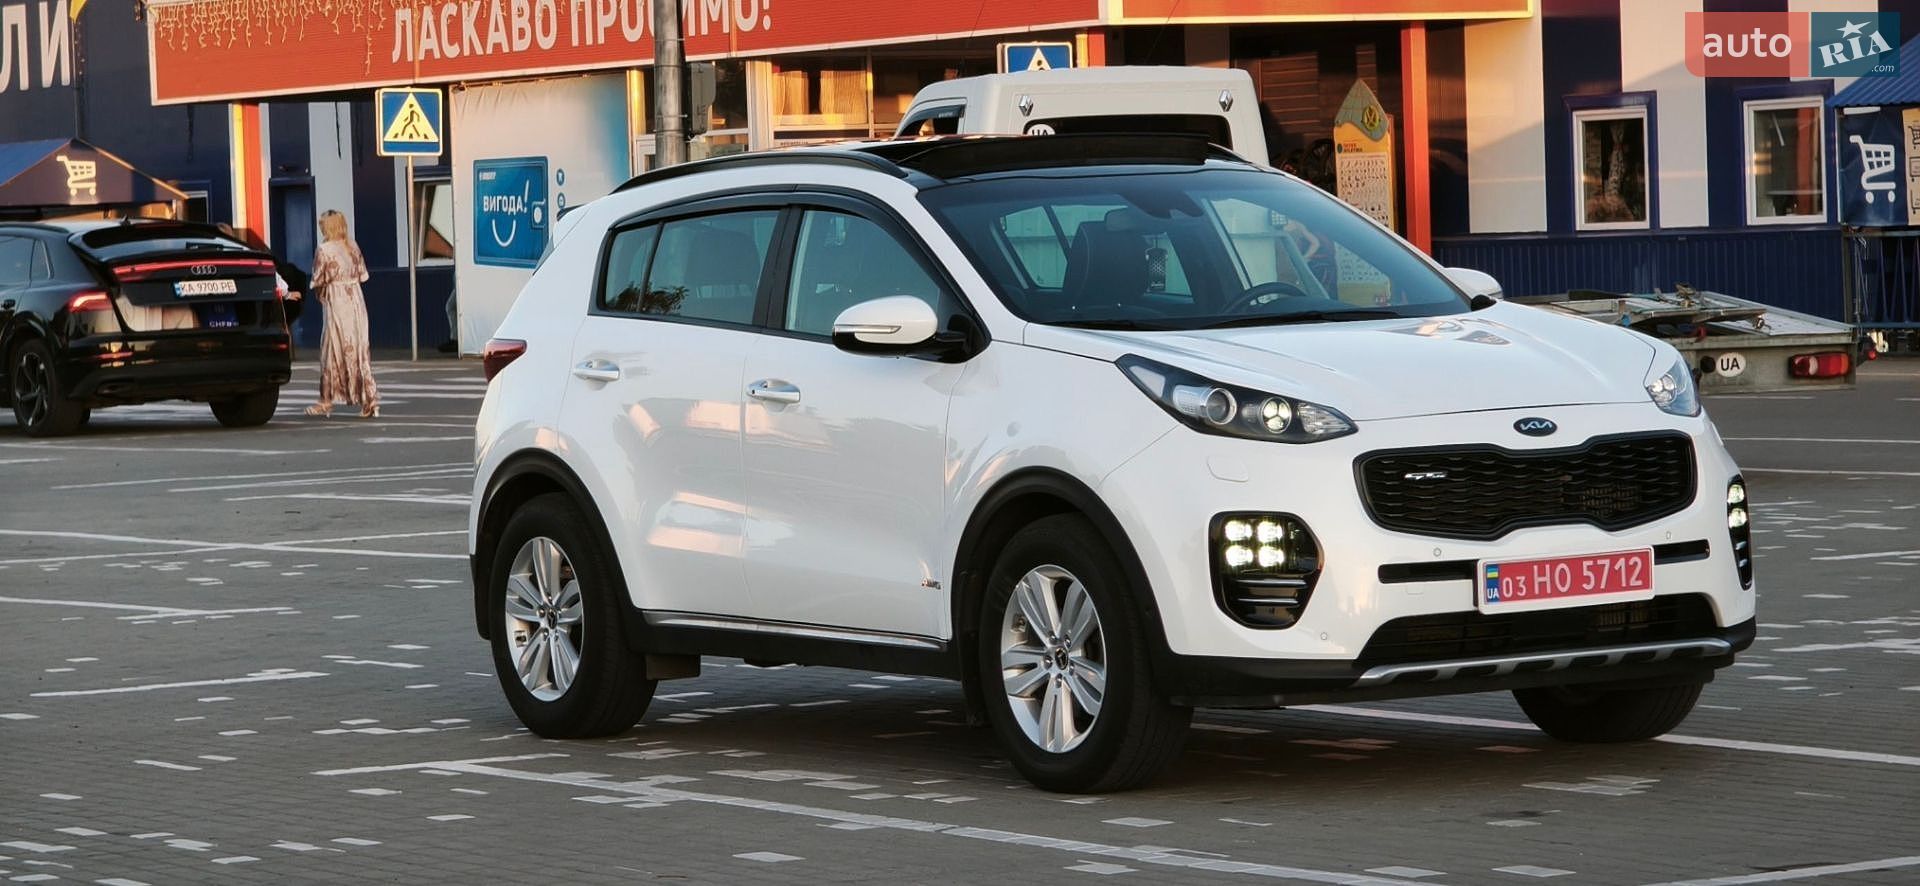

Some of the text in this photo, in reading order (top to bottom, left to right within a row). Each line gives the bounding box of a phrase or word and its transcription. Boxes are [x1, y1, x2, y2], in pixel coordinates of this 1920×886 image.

[392, 0, 771, 63] ЛАСКАВО ПРОИМО!
[483, 180, 529, 215] ВИГОДА!
[197, 282, 218, 292] 9700
[1720, 357, 1741, 371] UA
[1502, 556, 1643, 598] 03 HO 5712
[1487, 588, 1500, 600] UA
